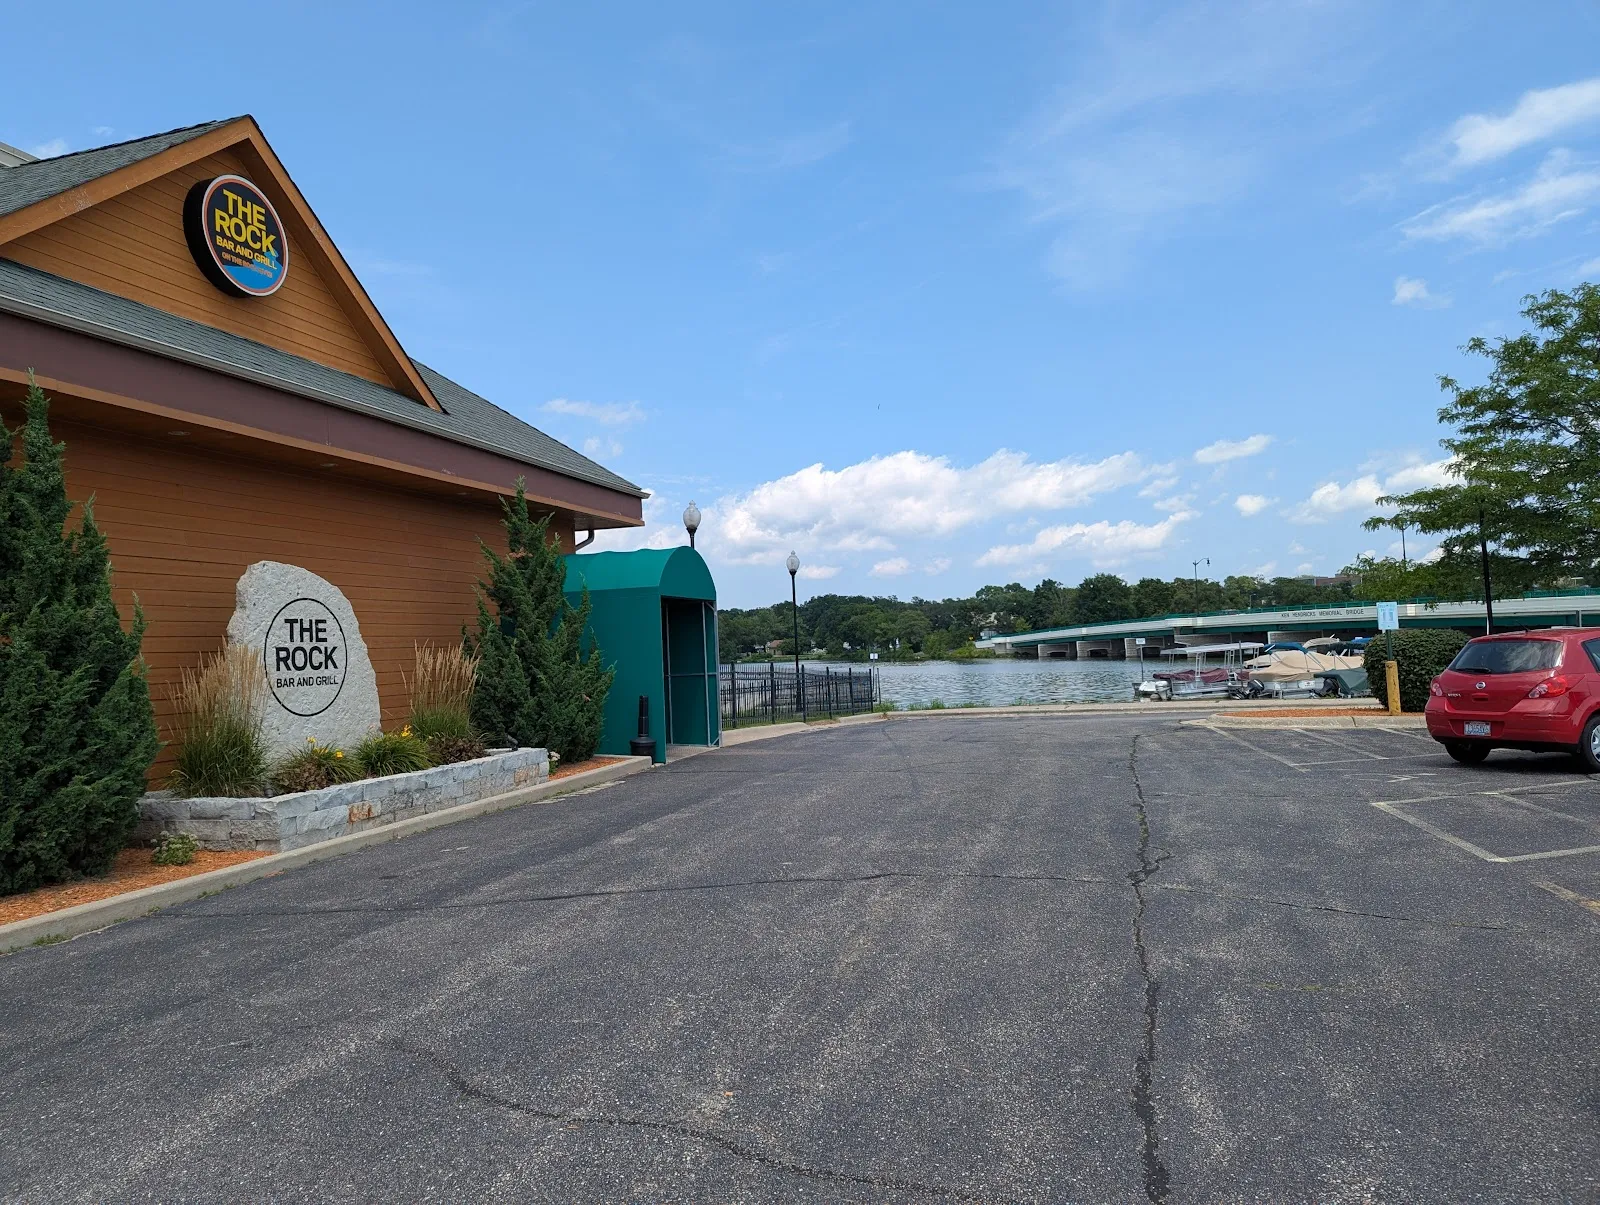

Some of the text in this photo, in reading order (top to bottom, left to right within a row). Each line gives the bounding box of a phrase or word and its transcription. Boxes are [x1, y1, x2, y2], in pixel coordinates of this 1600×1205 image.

[223, 188, 266, 230] THE
[215, 208, 277, 257] ROCK
[216, 235, 277, 270] BAR AND GRILL
[284, 618, 328, 643] THE
[275, 645, 339, 672] ROCK
[276, 675, 339, 689] BAR AND GRILL
